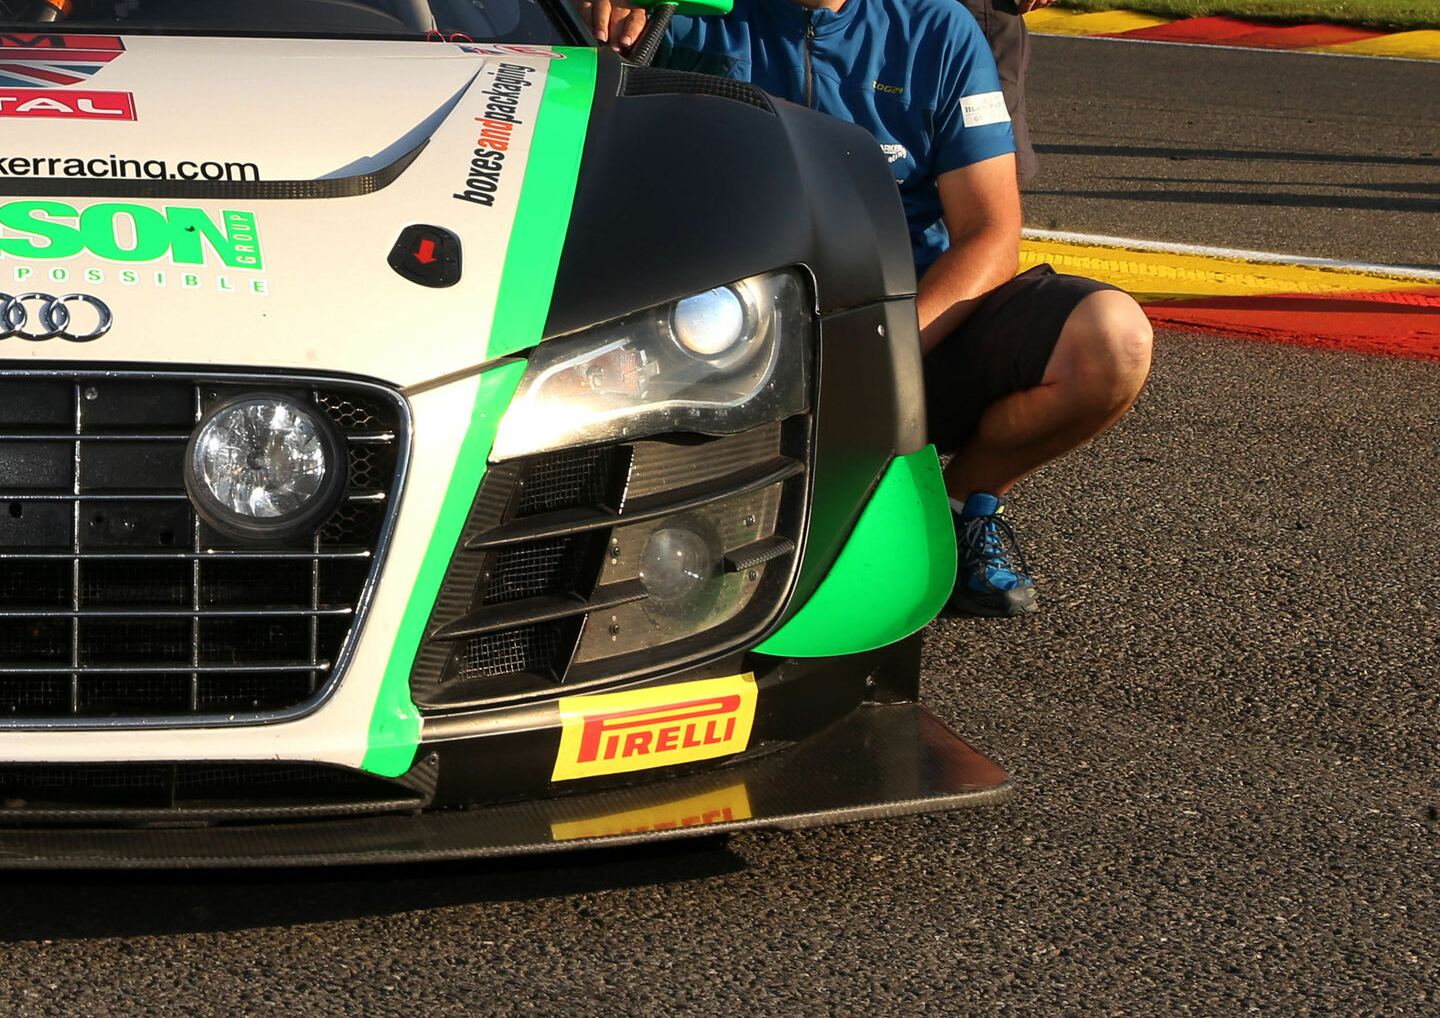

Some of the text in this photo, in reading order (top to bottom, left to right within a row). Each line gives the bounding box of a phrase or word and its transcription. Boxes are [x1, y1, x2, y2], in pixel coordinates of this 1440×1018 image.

[453, 62, 536, 207] boxesandpackaging
[230, 214, 258, 265] GROUP
[17, 268, 267, 294] POSSIBLE
[576, 694, 741, 763] PIRELLI
